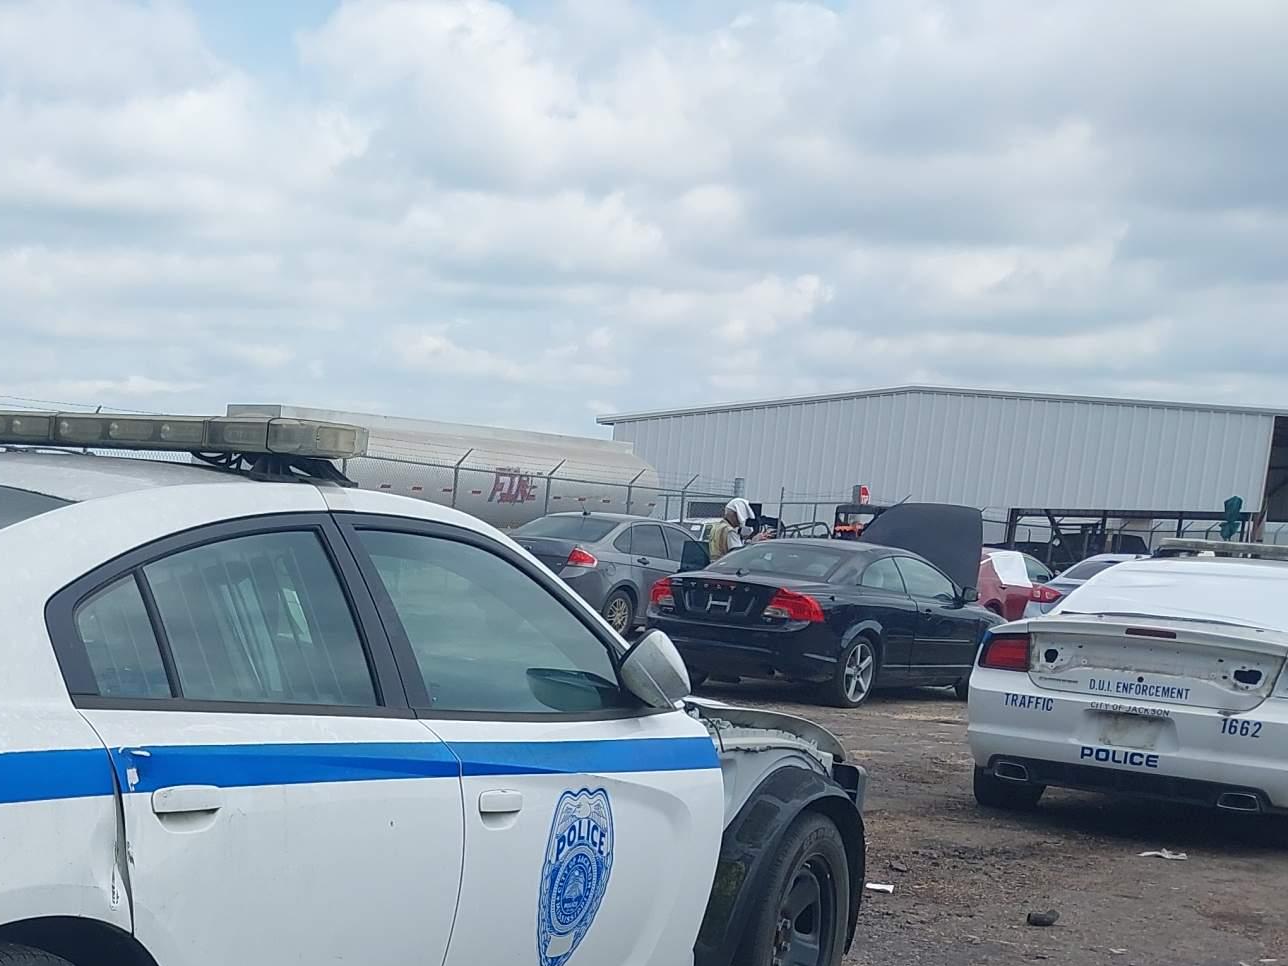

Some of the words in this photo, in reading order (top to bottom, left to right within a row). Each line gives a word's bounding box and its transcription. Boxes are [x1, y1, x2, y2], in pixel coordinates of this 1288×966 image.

[1089, 679, 1112, 692] D.U.I.
[1116, 681, 1190, 700] ENFORCEMENT
[1004, 692, 1054, 711] TRAFFIC
[1090, 701, 1110, 710] CITY
[1112, 703, 1123, 711] OF
[1126, 706, 1170, 717] JACKSON
[1220, 718, 1262, 738] 1662
[1080, 746, 1159, 768] POLICE
[555, 819, 606, 861] POLICE
